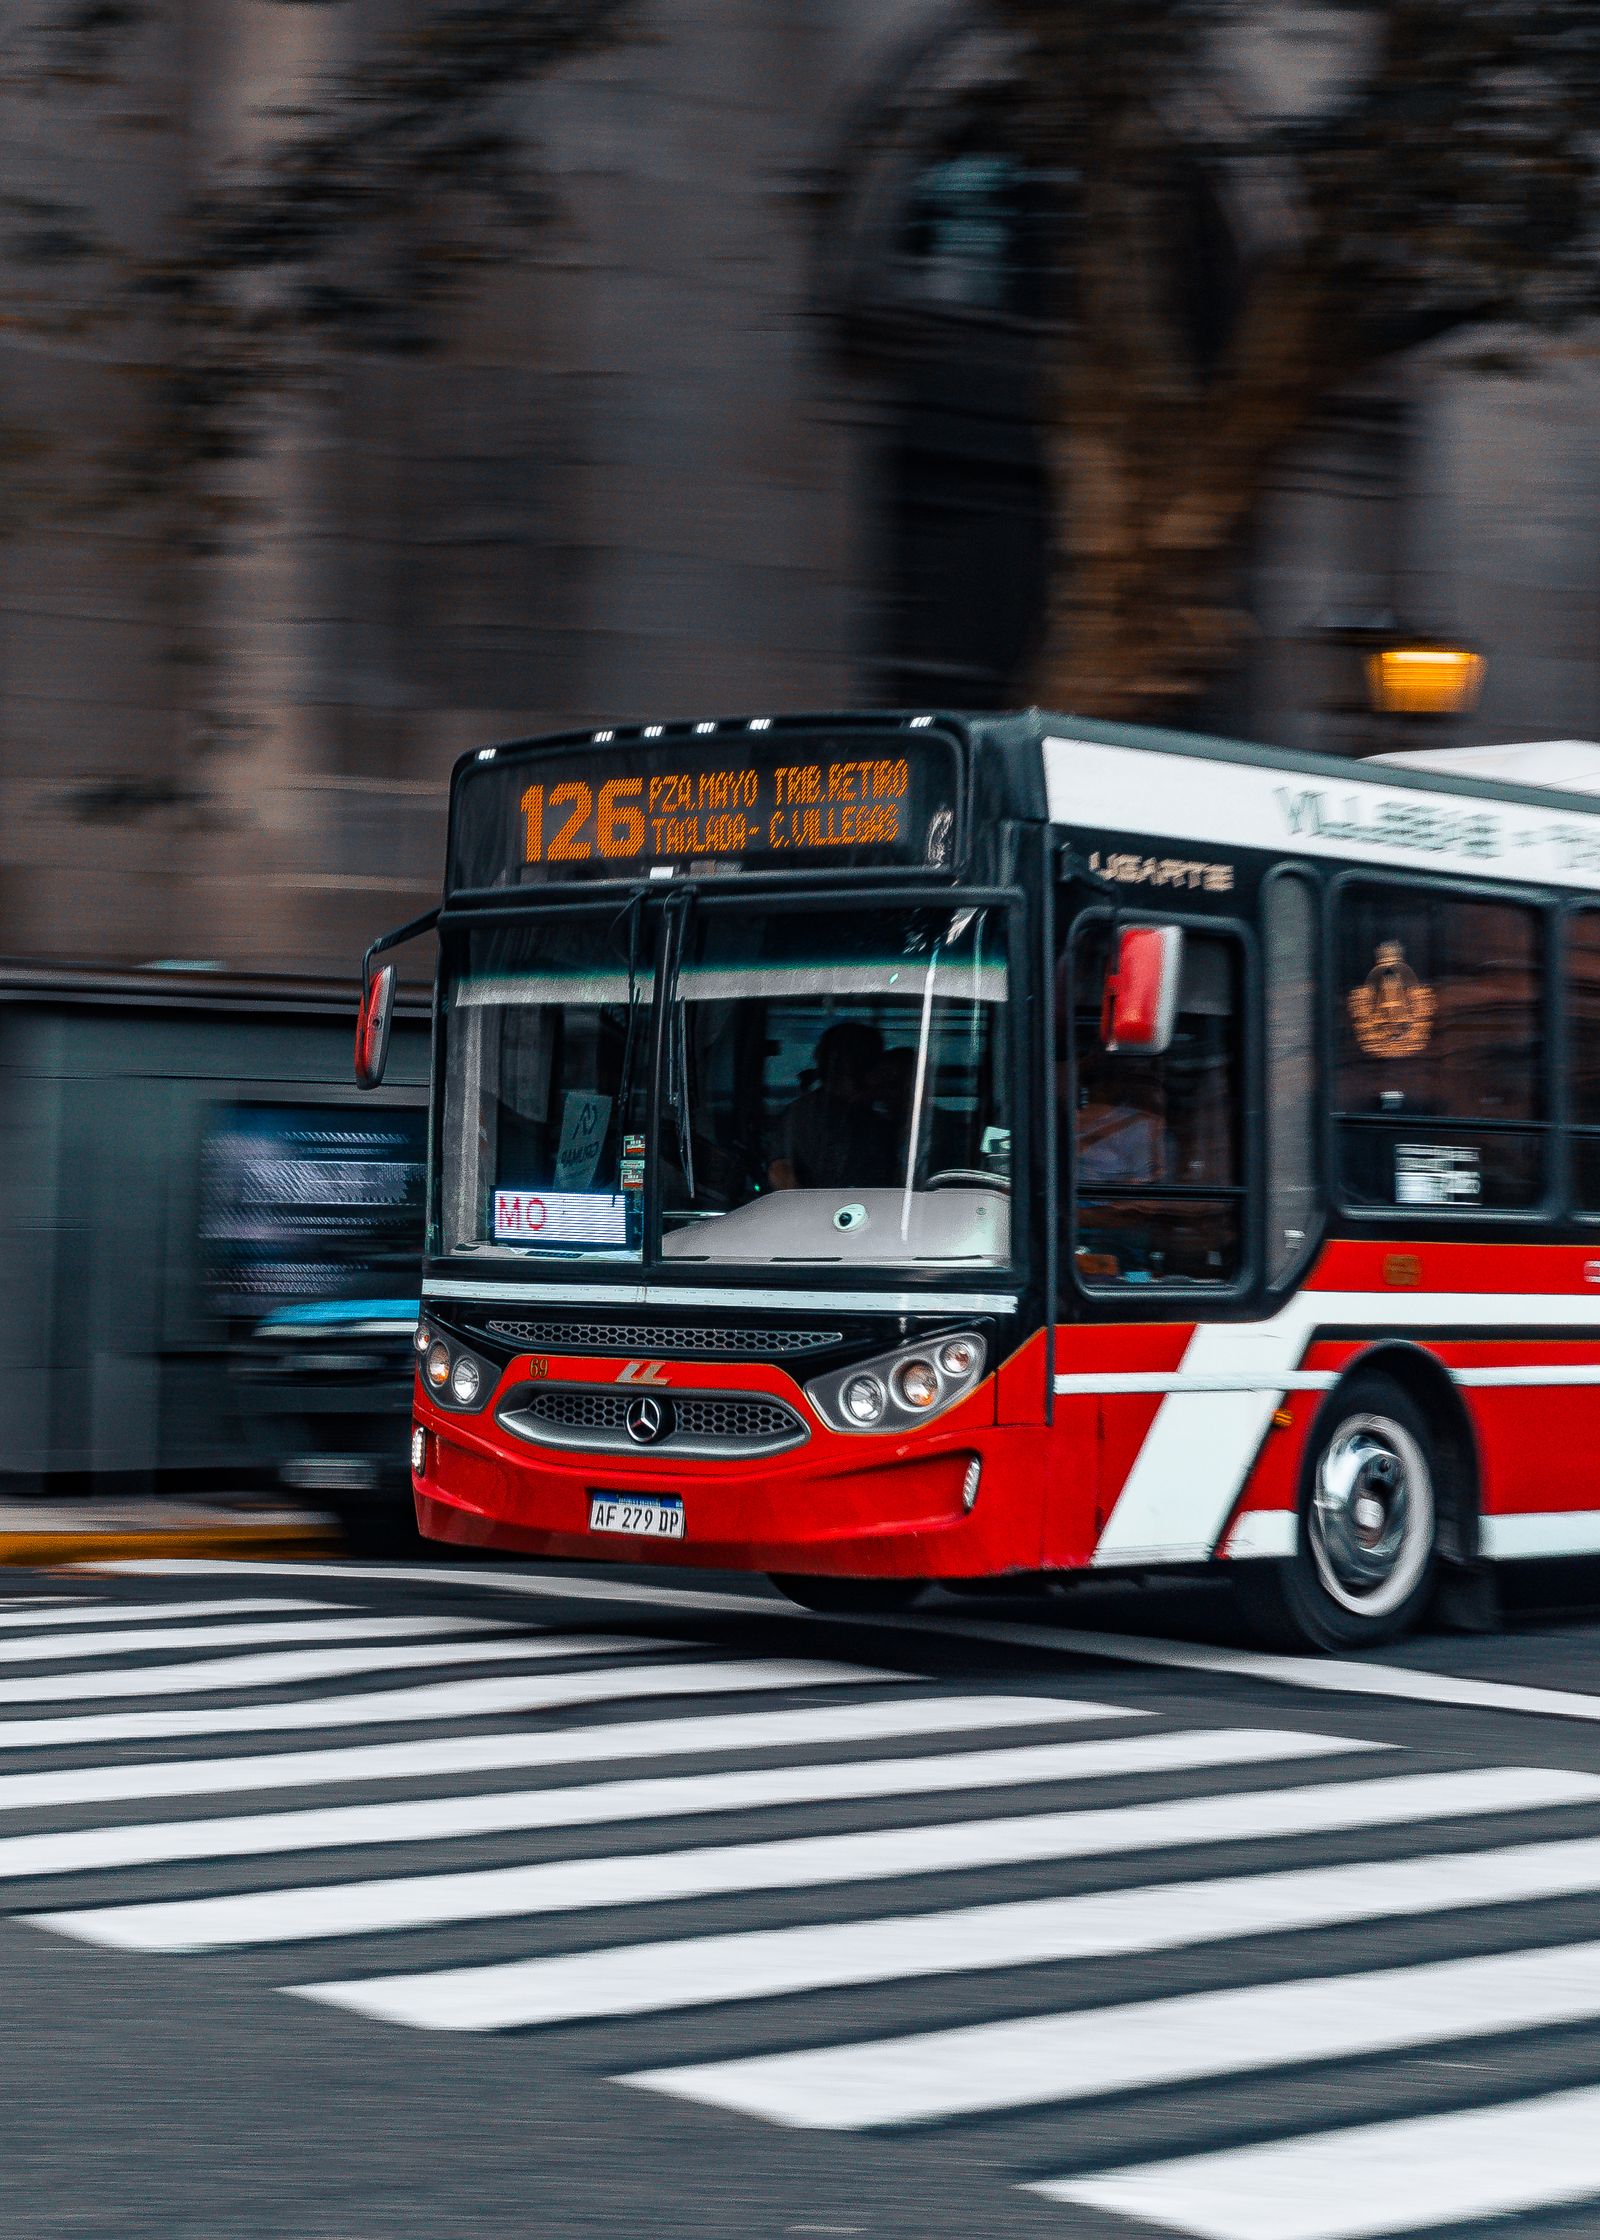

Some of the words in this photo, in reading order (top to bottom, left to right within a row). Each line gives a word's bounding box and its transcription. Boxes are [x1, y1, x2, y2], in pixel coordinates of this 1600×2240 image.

[520, 778, 645, 863] 126
[529, 1357, 549, 1378] 69
[594, 1503, 618, 1527] AF
[621, 1506, 654, 1532] 279
[659, 1509, 680, 1534] DP
